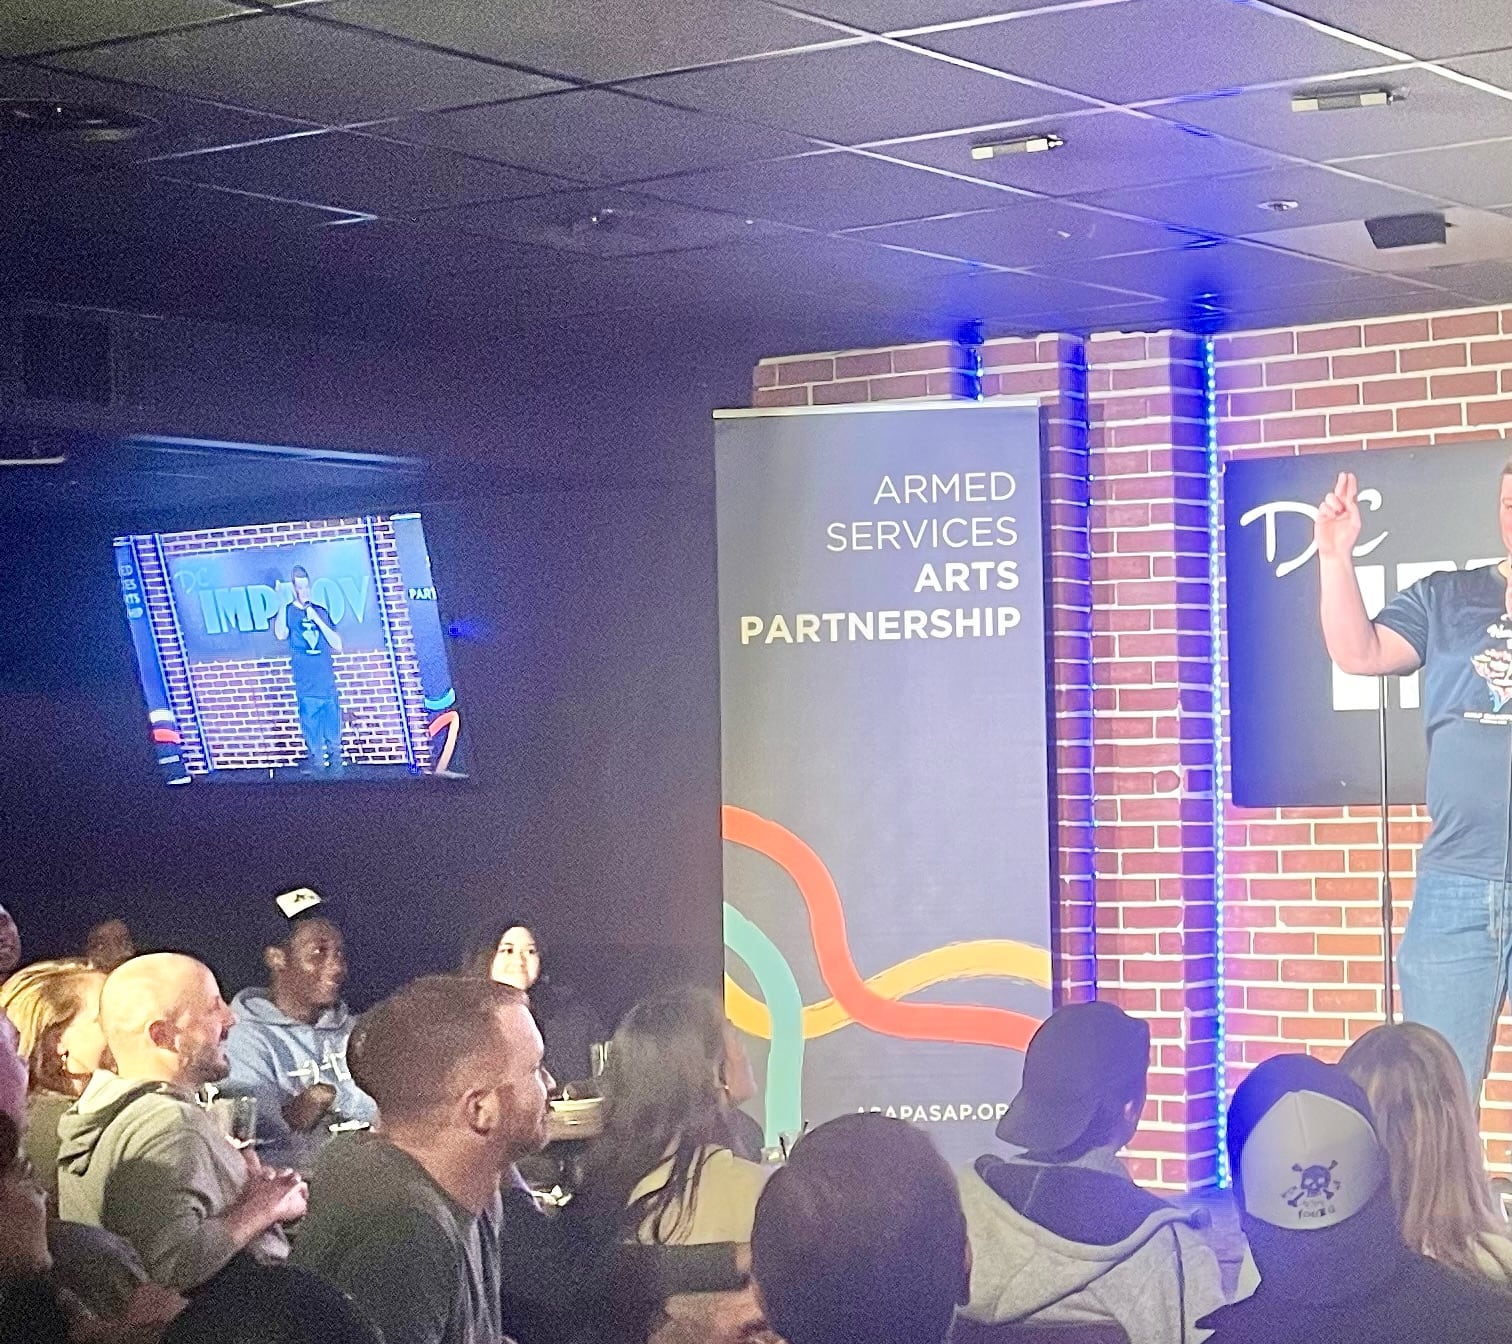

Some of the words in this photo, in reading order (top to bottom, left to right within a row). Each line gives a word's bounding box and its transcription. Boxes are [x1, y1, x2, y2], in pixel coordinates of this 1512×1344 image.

[873, 471, 1016, 505] ARMED
[826, 516, 1018, 552] SERVICES
[913, 560, 1020, 593] ARTS
[200, 575, 370, 635] IMPOV
[741, 606, 1021, 645] PARTNERSHIP
